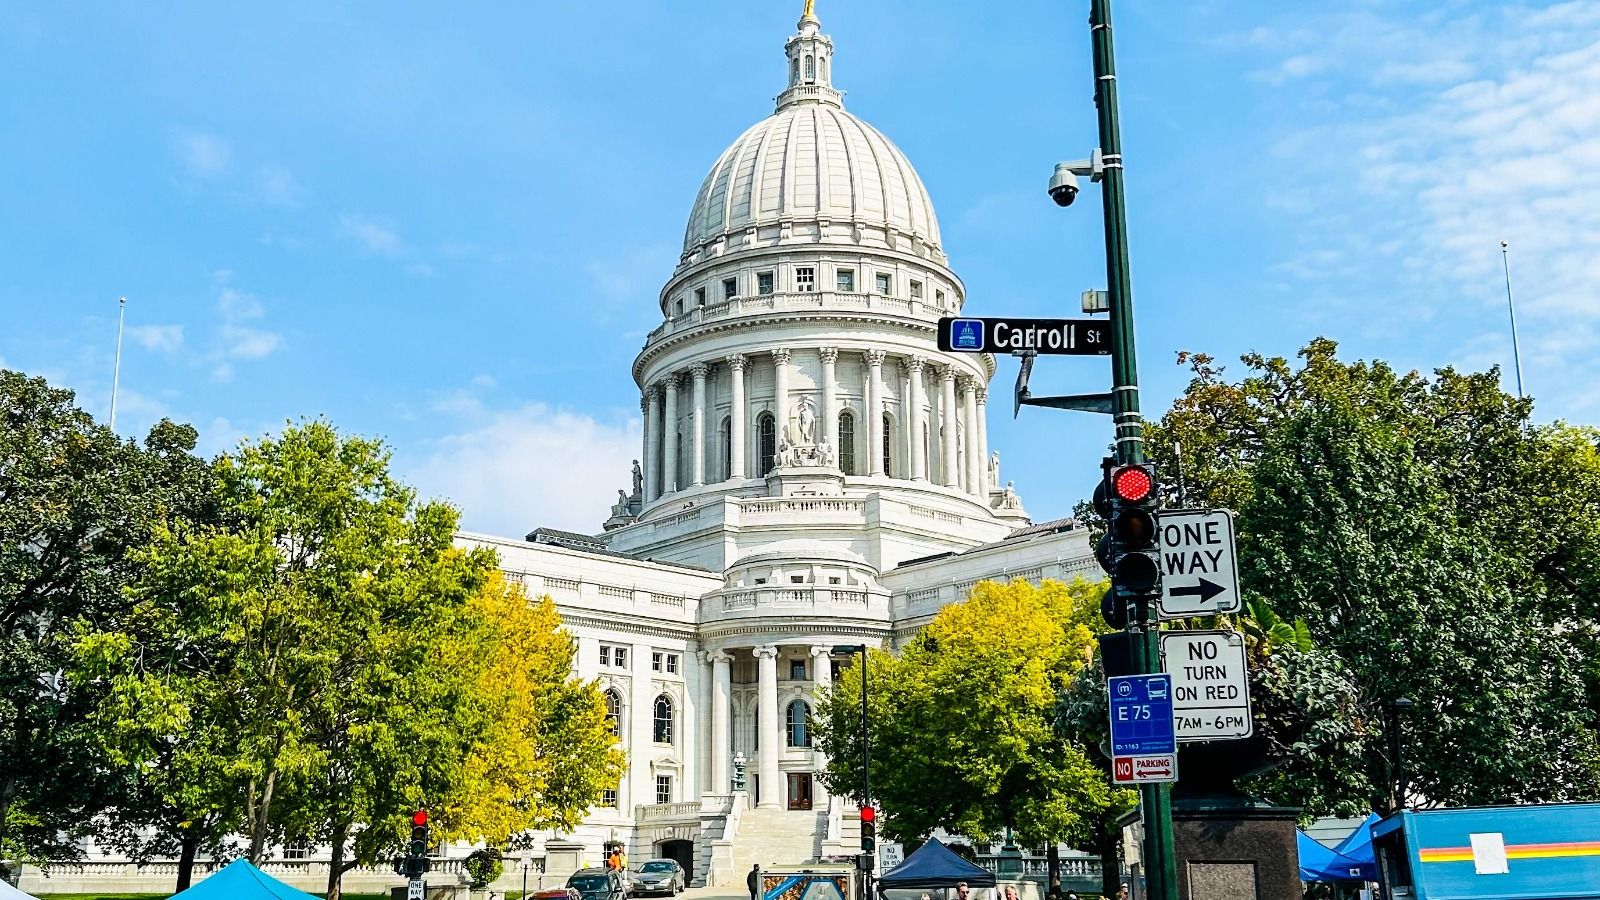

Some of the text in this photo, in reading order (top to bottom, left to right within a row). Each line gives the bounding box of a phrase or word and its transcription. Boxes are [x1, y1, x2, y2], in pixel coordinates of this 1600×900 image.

[993, 322, 1101, 349] Carroll St
[1164, 521, 1222, 547] ONE
[1164, 549, 1224, 576] WAY
[1188, 641, 1217, 660] NO
[1183, 665, 1227, 680] TURN
[1175, 685, 1238, 701] ON RED
[1118, 704, 1151, 721] E 75
[1174, 716, 1202, 730] 7AM
[1214, 716, 1244, 729] 6PM
[1117, 759, 1170, 776] NO PARKING
